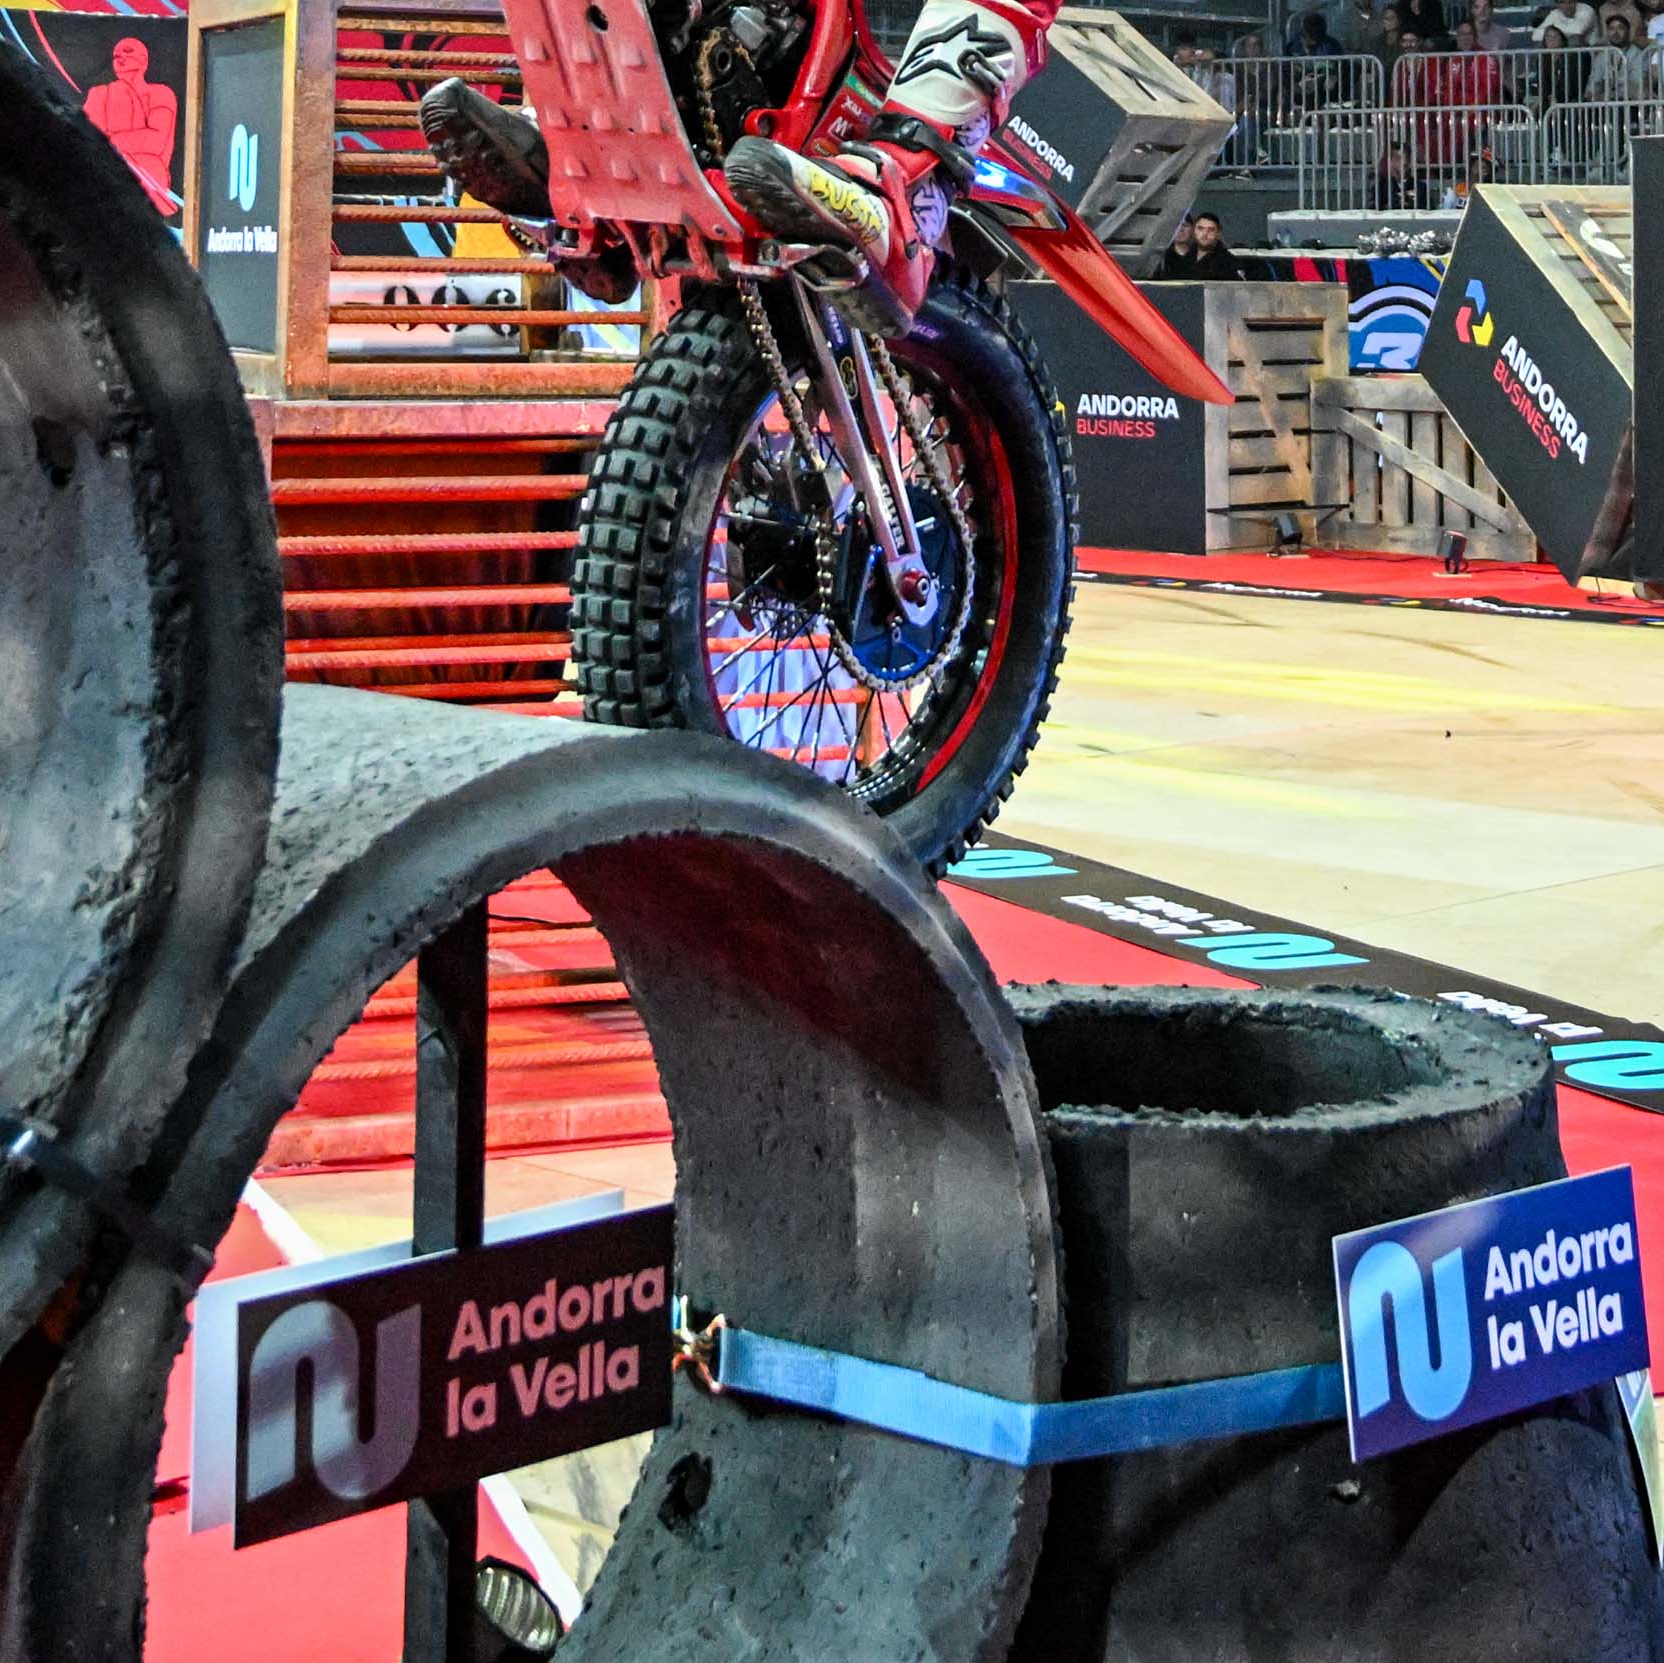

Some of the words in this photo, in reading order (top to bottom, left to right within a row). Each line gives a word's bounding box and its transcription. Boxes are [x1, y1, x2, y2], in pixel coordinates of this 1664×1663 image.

[1008, 116, 1075, 183] ANDORRA
[1077, 393, 1180, 420] ANDORRA
[1077, 419, 1156, 438] BUSINESS
[1493, 358, 1562, 459] BUSINESS
[1501, 335, 1590, 465] ANDORRA
[1484, 1216, 1634, 1305] Andorra
[444, 1263, 667, 1363] Andorra
[1487, 1312, 1527, 1371] la
[1535, 1285, 1624, 1356] Vella
[443, 1374, 498, 1439] la
[512, 1342, 641, 1423] Vella
